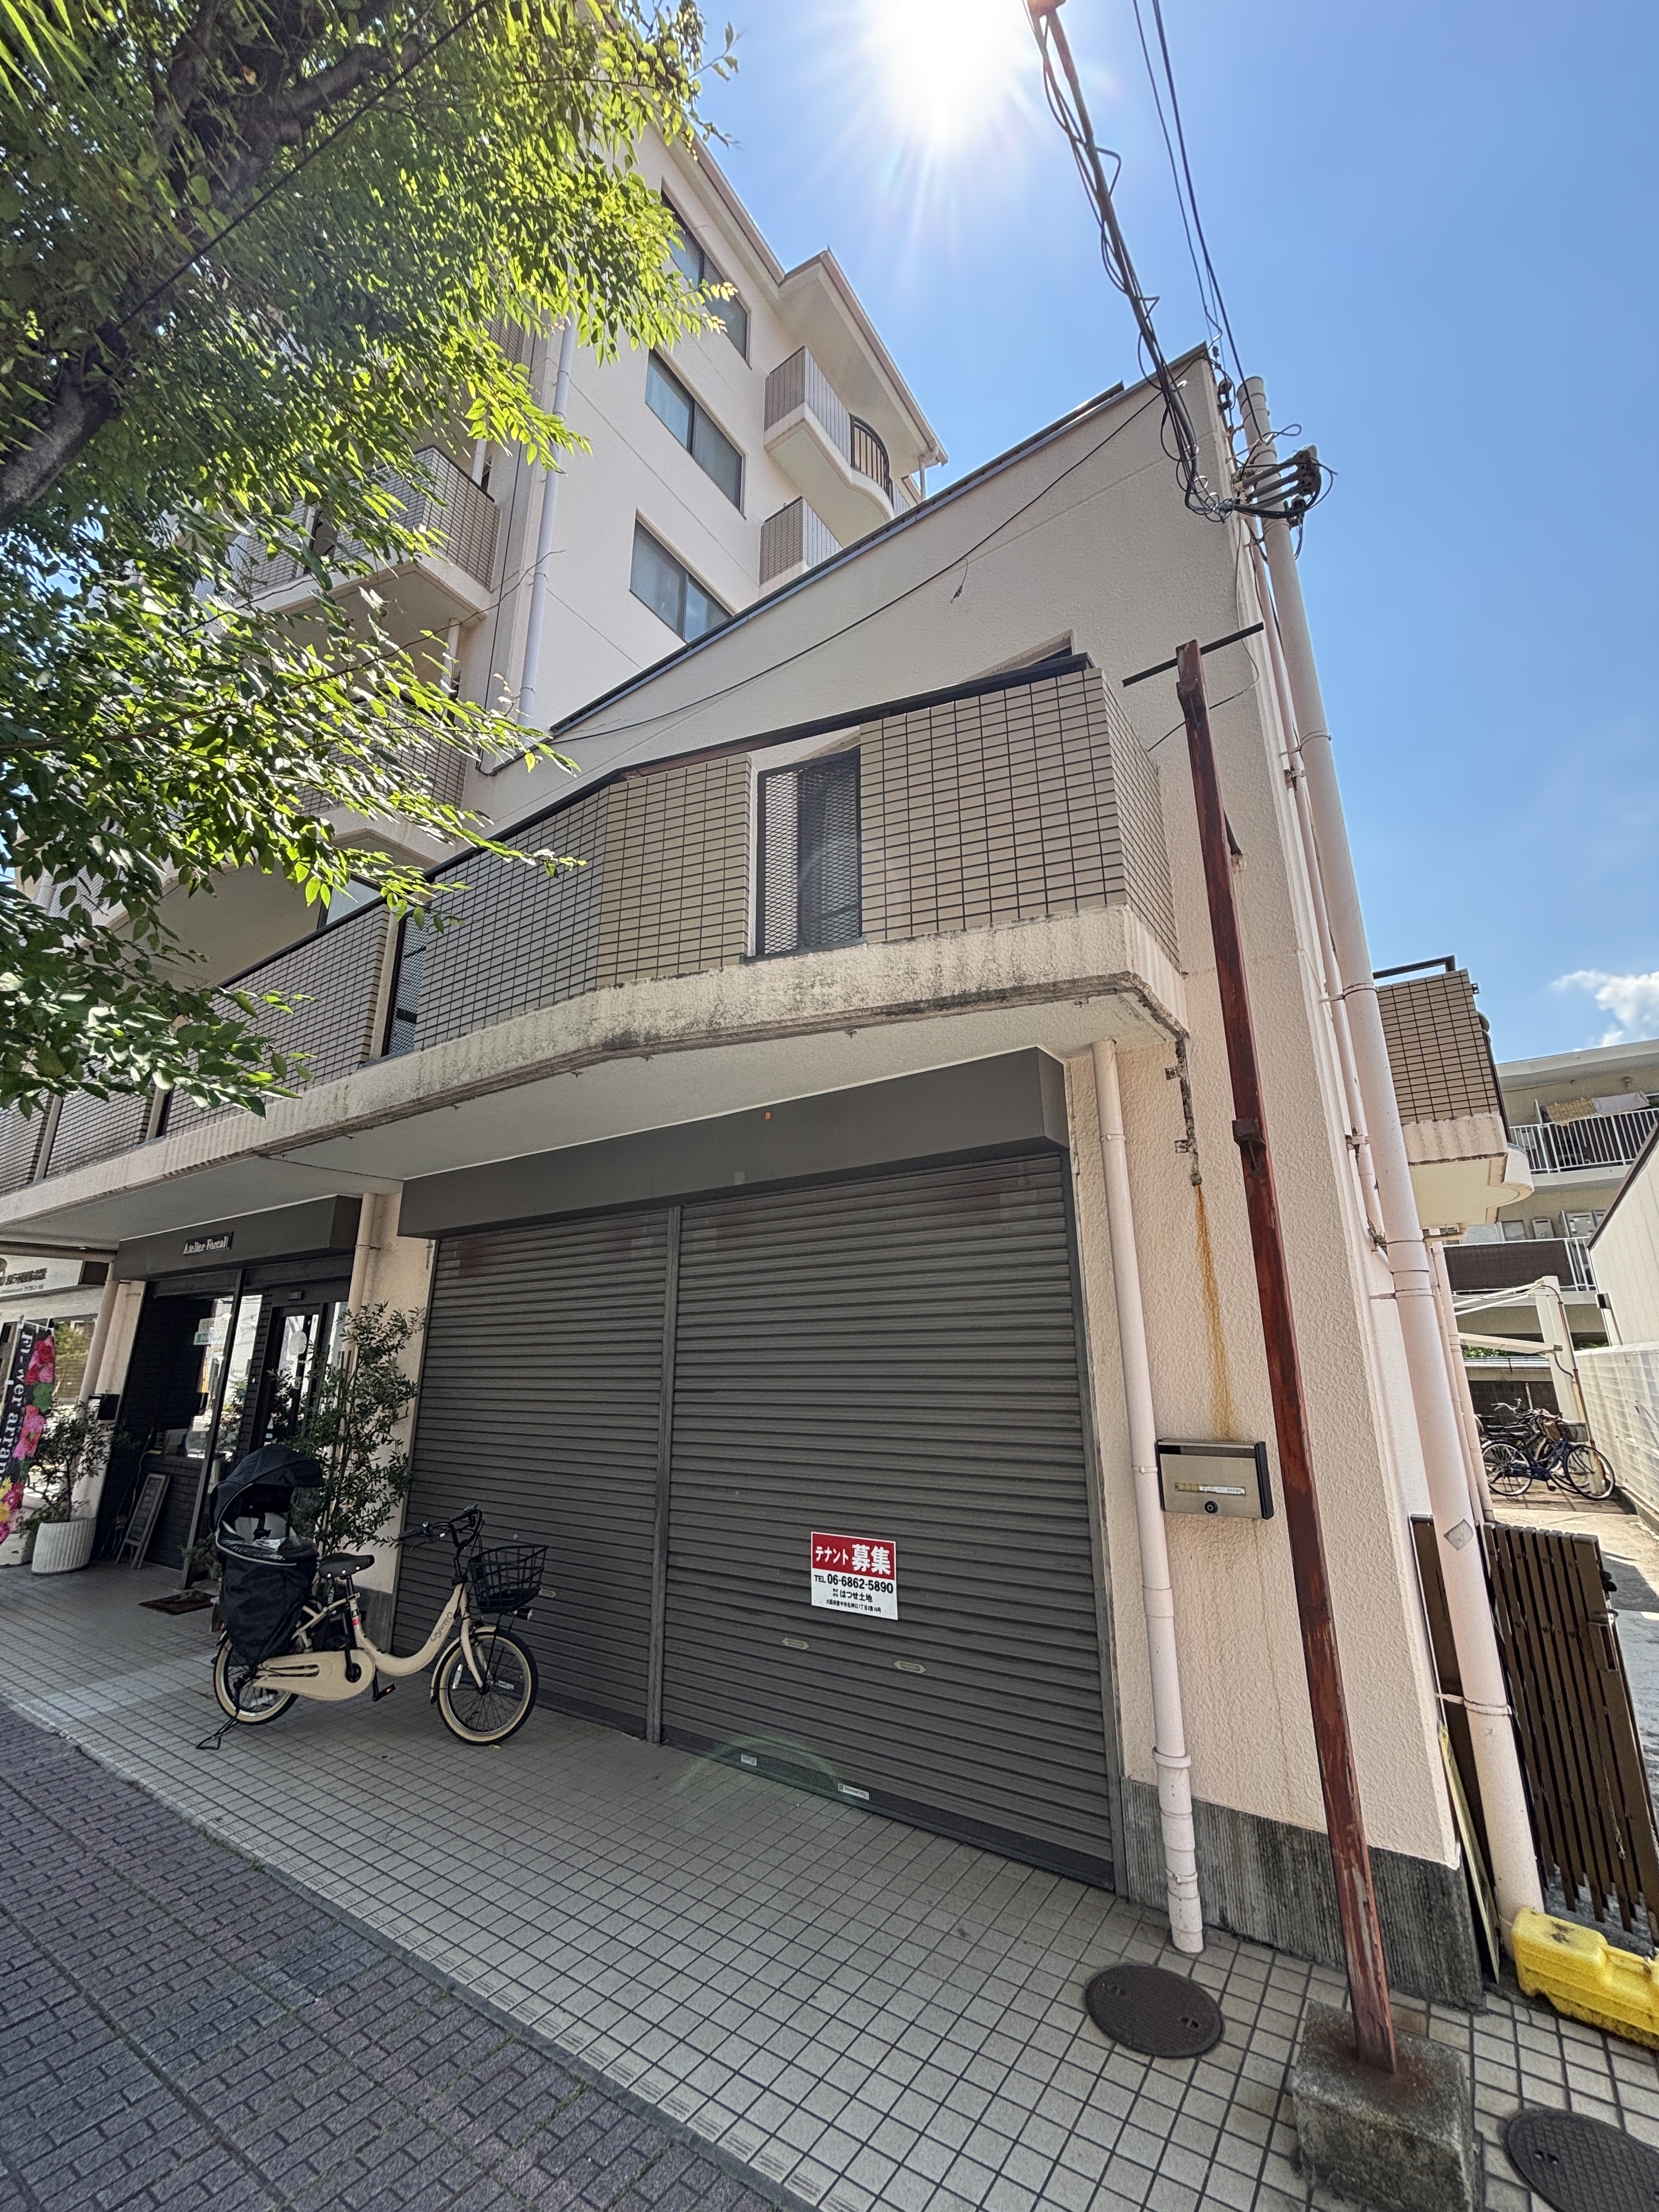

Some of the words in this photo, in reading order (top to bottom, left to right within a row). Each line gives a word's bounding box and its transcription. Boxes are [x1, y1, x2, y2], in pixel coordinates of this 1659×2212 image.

[0, 1412, 18, 1481] arran
[815, 1544, 891, 1575] テナント募集
[814, 1575, 826, 1583] TEL
[827, 1573, 893, 1594] 06-6862-5890
